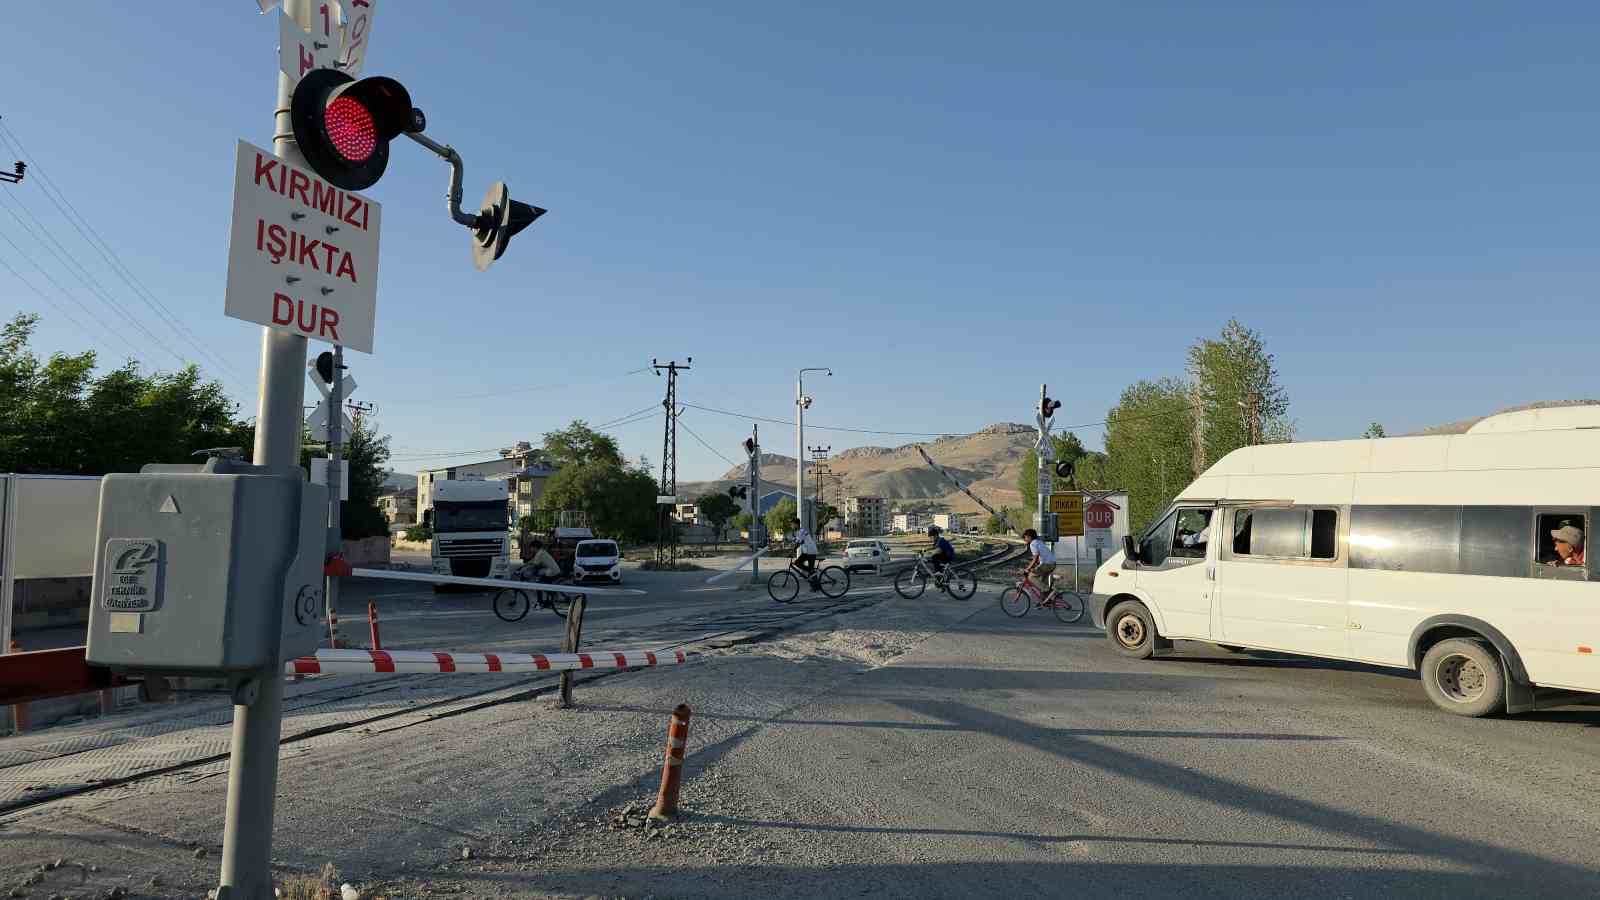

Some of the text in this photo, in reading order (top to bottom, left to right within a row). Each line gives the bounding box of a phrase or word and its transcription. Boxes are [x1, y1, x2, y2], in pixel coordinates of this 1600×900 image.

[254, 152, 369, 232] KIRMIZI
[256, 219, 357, 283] IŞIKTA
[271, 292, 340, 341] DUR
[1087, 511, 1111, 523] DUR
